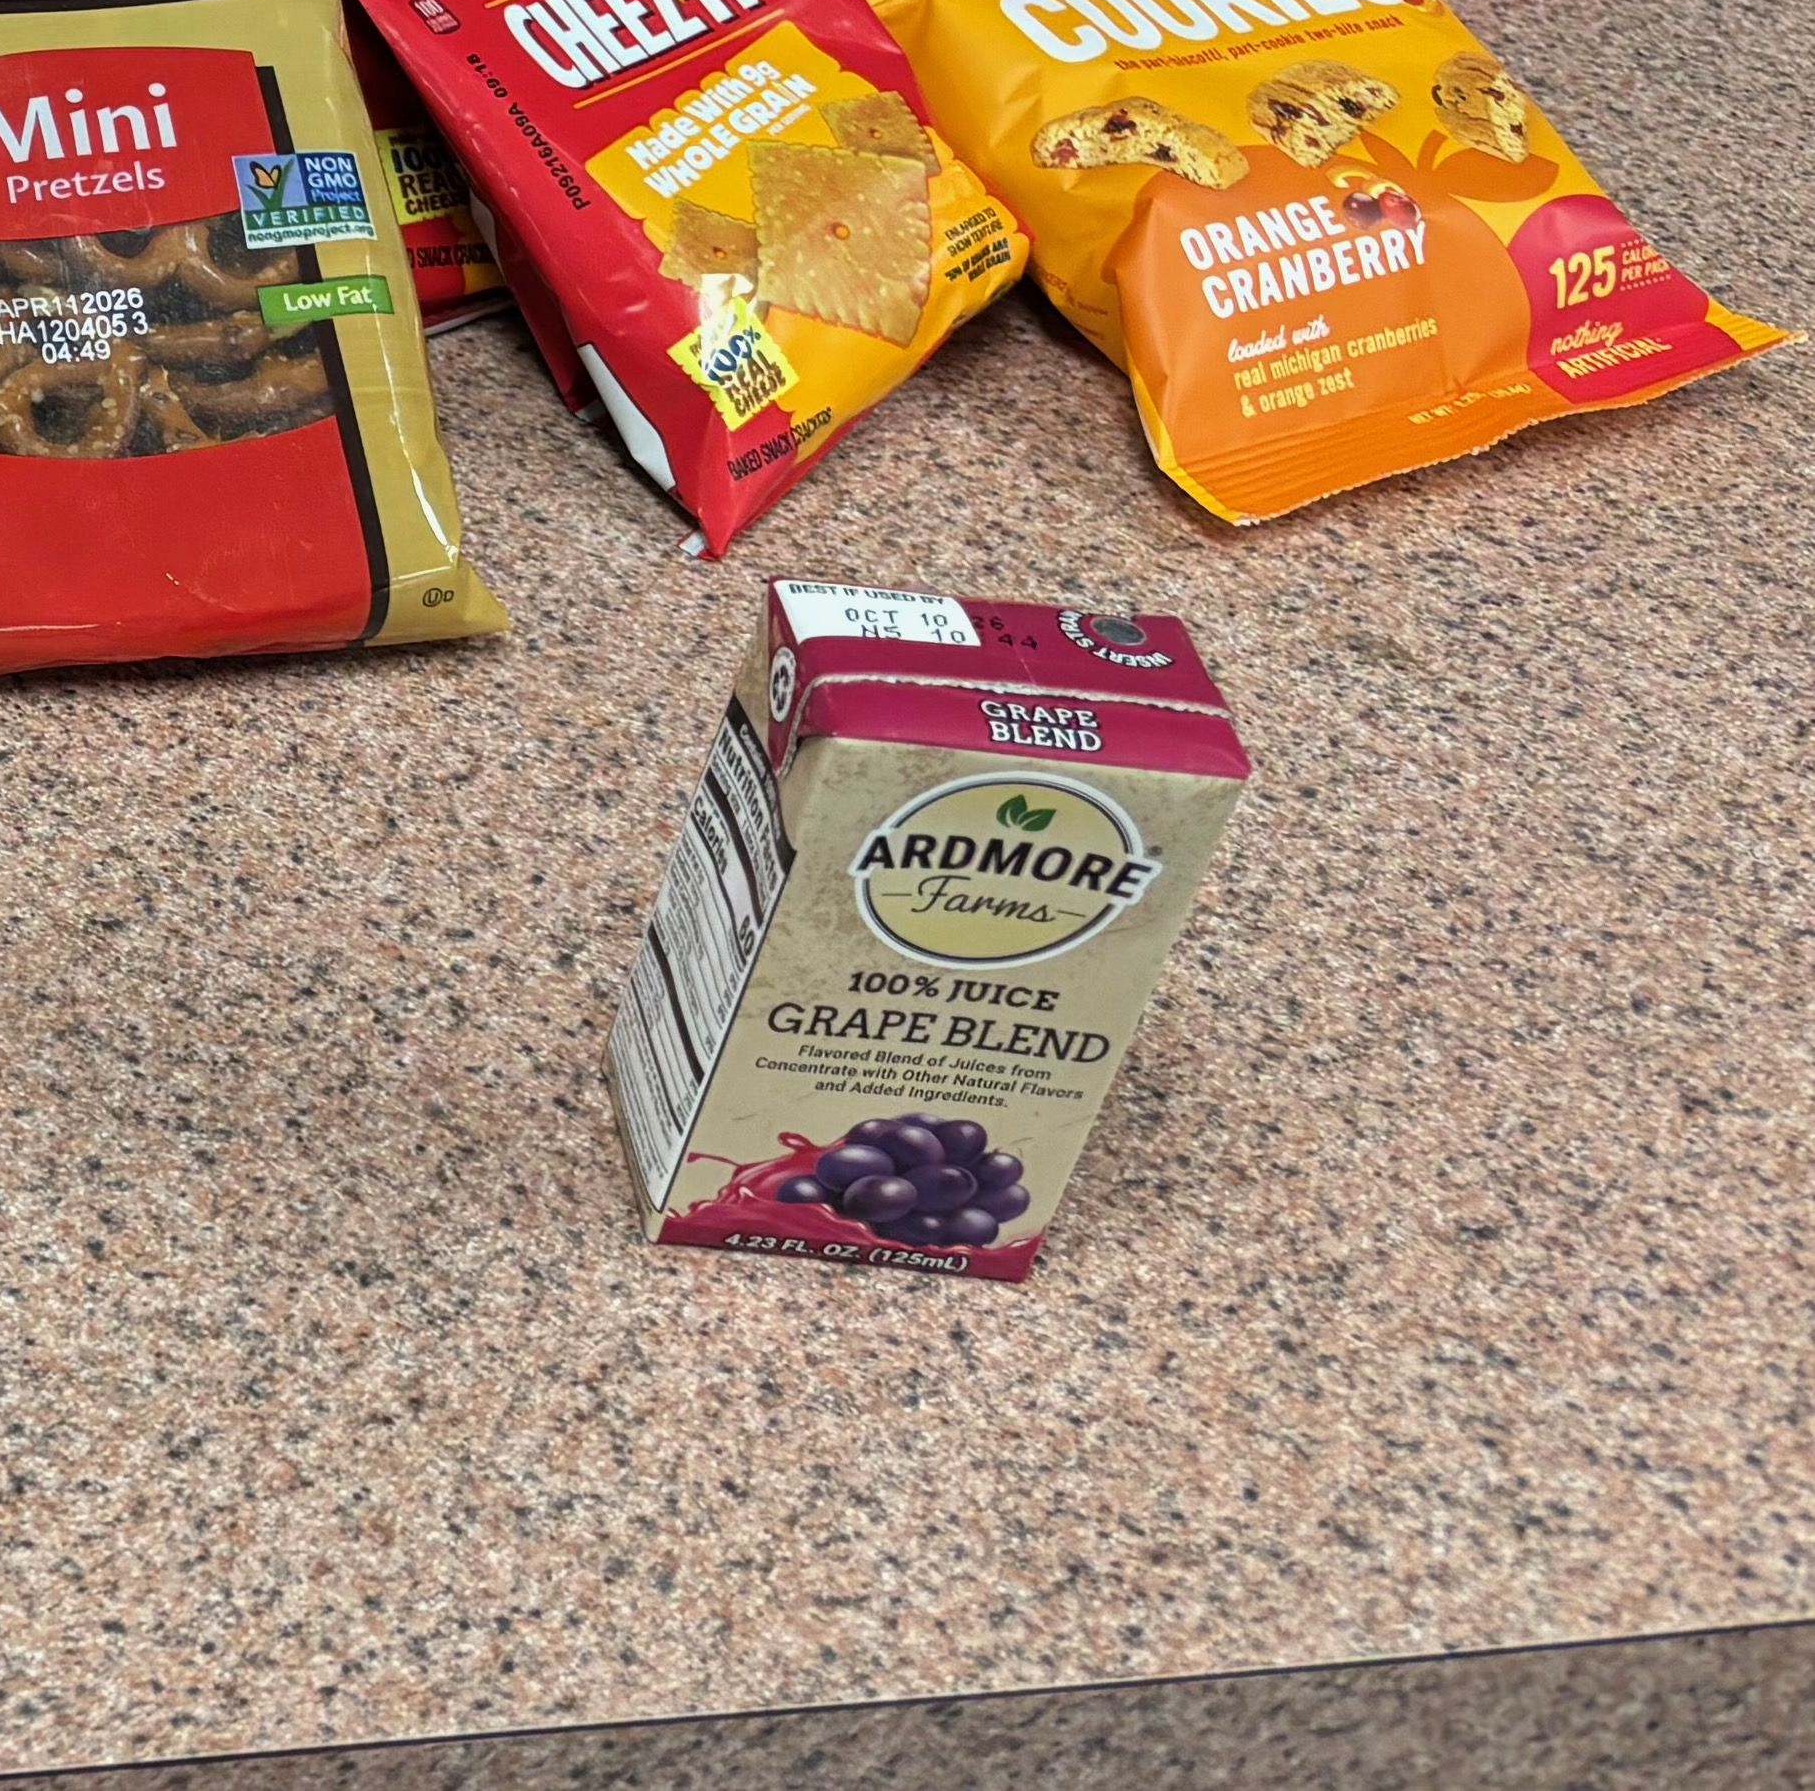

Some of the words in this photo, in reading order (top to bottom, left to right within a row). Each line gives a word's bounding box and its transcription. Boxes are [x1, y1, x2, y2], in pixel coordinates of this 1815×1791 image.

[625, 106, 687, 171] Made
[683, 78, 746, 127] With
[742, 58, 783, 97] 9g
[643, 125, 735, 199] WHOLE
[726, 74, 817, 137] GRAIN
[4, 161, 166, 204] Pretzels
[303, 155, 355, 174] NON
[306, 171, 358, 191] GMO
[249, 206, 368, 227] VERIFIED
[310, 185, 365, 207] Project
[1179, 195, 1345, 272] ORANGE
[1200, 220, 1430, 320] CRANBERRY
[1548, 245, 1617, 310] 125
[282, 290, 333, 313] Low
[335, 284, 373, 307] Fat
[41, 339, 111, 364] 04:49
[1226, 331, 1286, 363] loaded
[1289, 315, 1331, 346] with
[1233, 360, 1268, 390] real
[1271, 340, 1343, 376] michigan
[1347, 315, 1439, 358] cranberries
[1549, 318, 1624, 355] nothing
[1239, 393, 1255, 418] &
[1257, 376, 1313, 418] orange
[1317, 367, 1354, 398] zest
[726, 449, 763, 482] BAKED
[759, 430, 796, 466] SNACK
[980, 698, 1100, 729] GRAPE
[990, 720, 1103, 753] BLEND
[858, 831, 1156, 901] ARDMORE
[910, 874, 1057, 926] Farms
[847, 969, 939, 999] 100%
[944, 975, 1060, 1012] JUICE
[767, 1000, 938, 1046] GRAPE
[940, 1012, 1111, 1065] BLEND
[754, 1055, 858, 1080] Concentrate
[860, 1065, 899, 1083] with
[901, 1070, 949, 1089] Other
[952, 1074, 1018, 1094] Natural
[1019, 1080, 1085, 1102] Flavors
